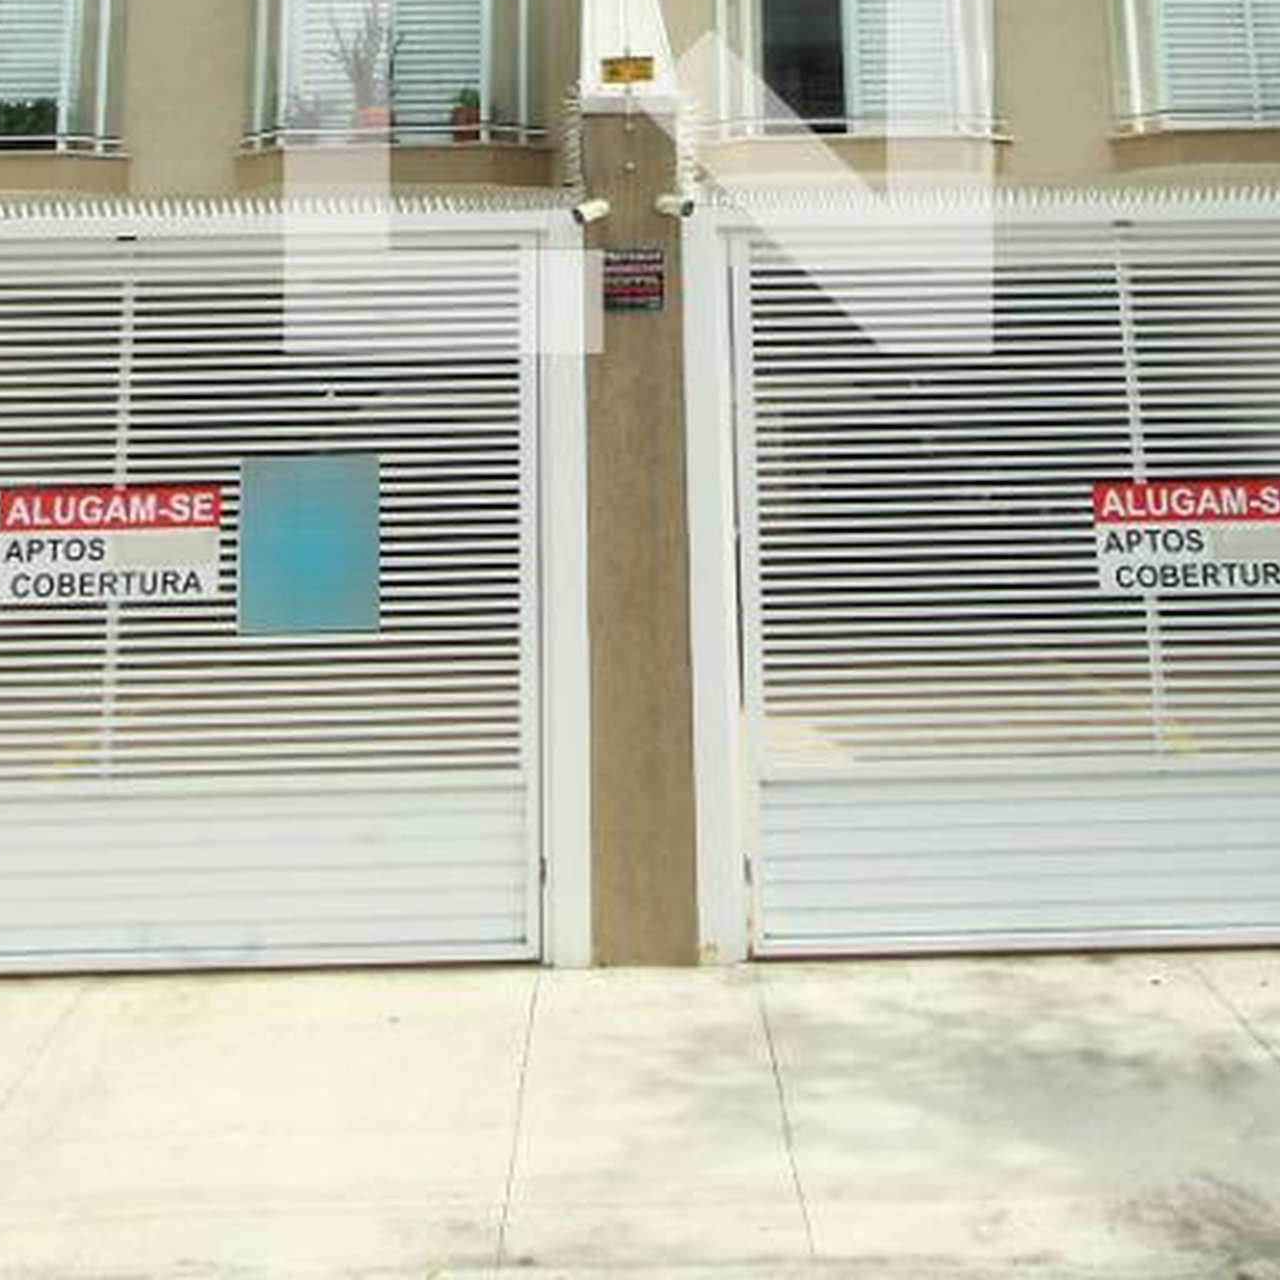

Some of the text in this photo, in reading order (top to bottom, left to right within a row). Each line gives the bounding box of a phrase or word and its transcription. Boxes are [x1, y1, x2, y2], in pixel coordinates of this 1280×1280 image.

[5, 492, 215, 525] ALUGAM-SE
[4, 538, 107, 563] APTOS
[1103, 528, 1205, 554] APTOS
[10, 571, 202, 599] COBERTURA
